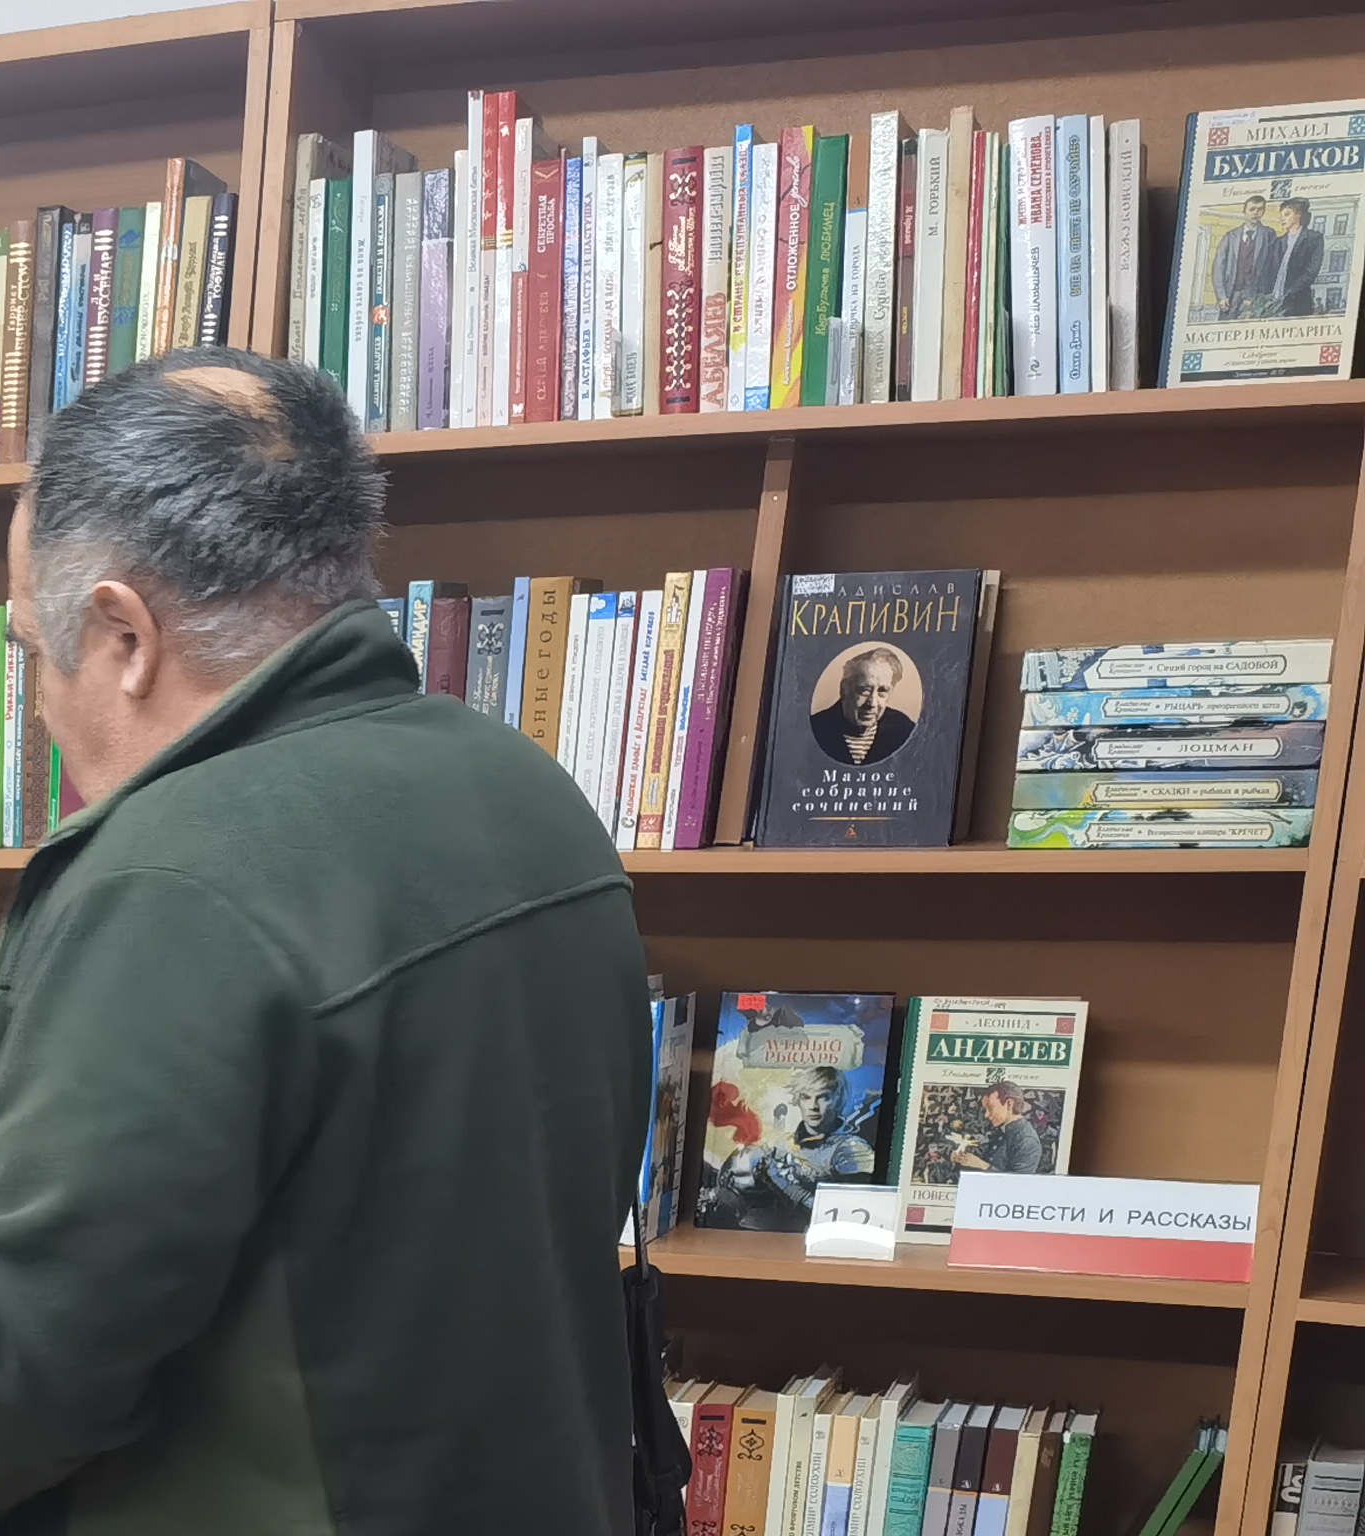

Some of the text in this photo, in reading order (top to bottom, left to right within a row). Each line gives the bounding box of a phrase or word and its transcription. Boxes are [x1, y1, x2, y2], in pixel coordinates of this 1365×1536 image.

[1245, 122, 1330, 142] МИХАИЛ
[1213, 144, 1360, 178] БУЛГАКОВ
[927, 157, 941, 237] М. ГОРЬКИЙ
[1030, 189, 1042, 224] ИВАНА
[535, 194, 548, 253] СЕКРЕТНАЯ
[546, 197, 556, 244] ПРОСЬБА
[582, 191, 593, 255] ПАСТУШКА
[785, 204, 800, 291] ОТЛОЖЕННОЕ
[815, 201, 835, 335] Кир ЛЮБИМЕЦ
[98, 251, 113, 325] БУССЕНАР
[582, 270, 592, 314] ПАСТУХ
[1185, 324, 1343, 344] МАСТЕР И МАРГАРИТА
[581, 328, 591, 386] АСТАФЬЕВ
[790, 596, 960, 637] КРАПИВИН
[1225, 659, 1279, 672] САДОВОЙ
[1164, 701, 1203, 711] РЫЦАРЬ
[1178, 742, 1254, 754] ЛОЦМАН
[802, 784, 912, 799] собрание
[822, 769, 895, 783] Малое
[1150, 786, 1190, 797] СКАЗКИ
[792, 800, 919, 812] сочинений
[973, 1019, 1031, 1030] ЛЕОНИД
[764, 1052, 839, 1065] РЫЦАРЬ
[931, 1036, 1067, 1062] АНДРЕЕВ
[978, 1201, 1253, 1233] ПОВЕСТИ И РАССКАЗЫ
